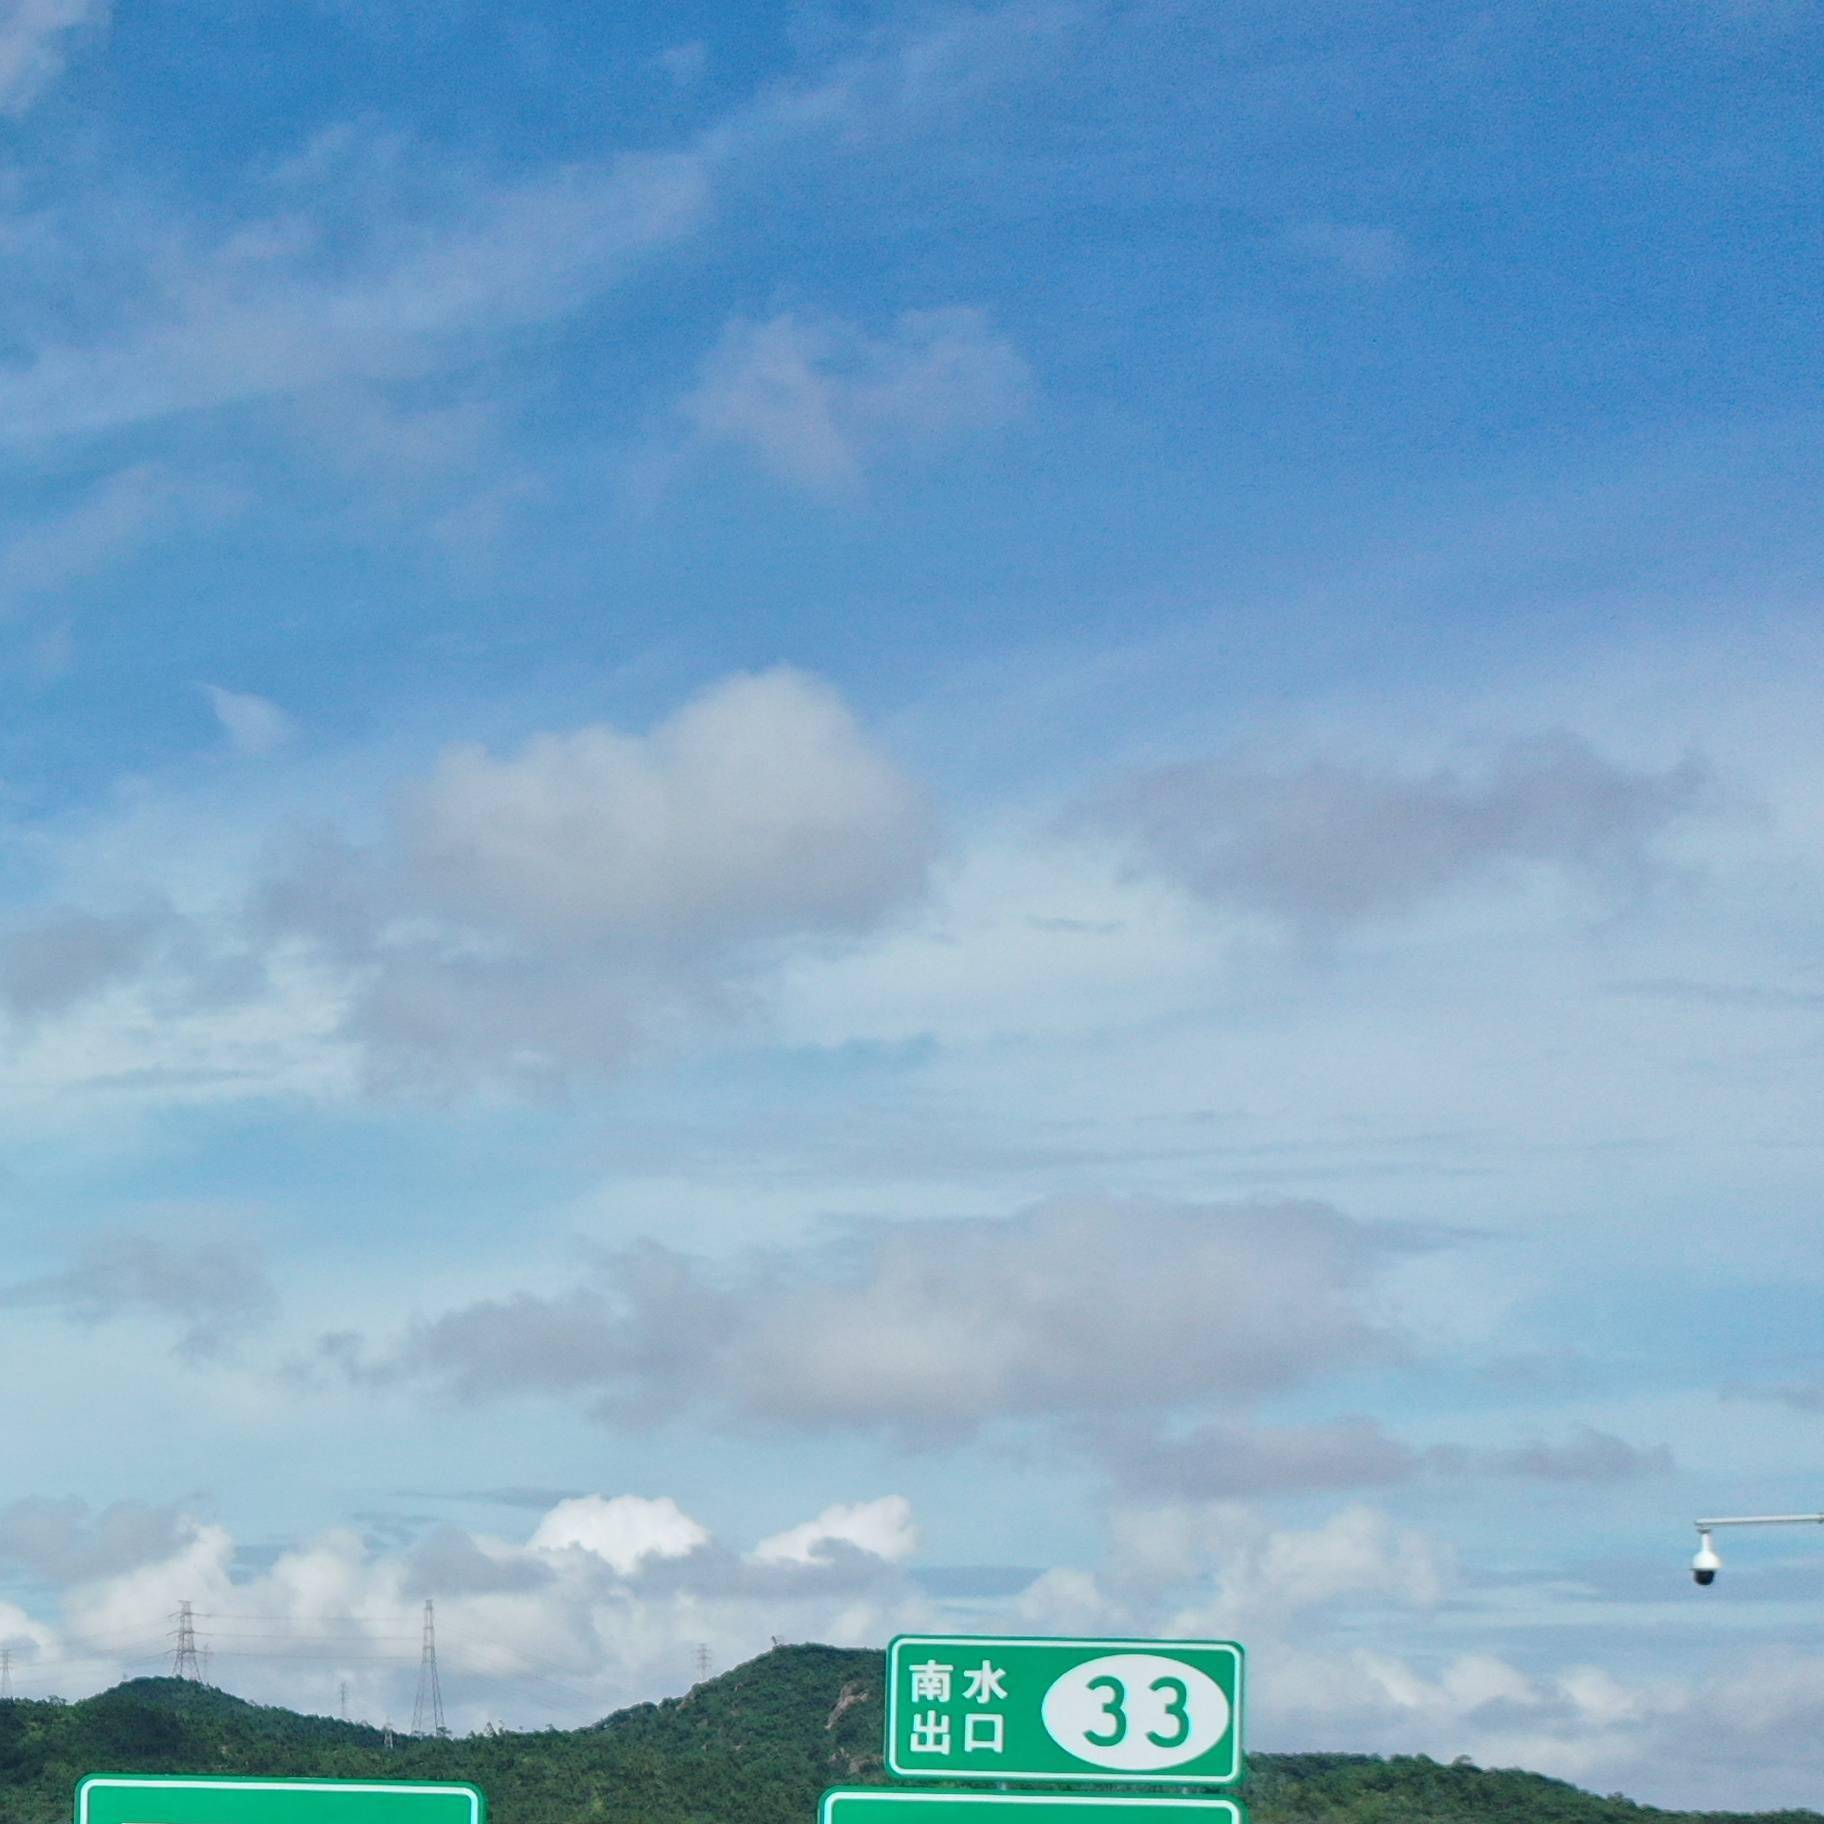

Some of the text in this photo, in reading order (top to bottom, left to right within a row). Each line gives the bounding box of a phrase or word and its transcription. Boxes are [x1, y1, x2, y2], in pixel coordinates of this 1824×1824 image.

[909, 1659, 1008, 1704] 南水
[910, 1710, 1004, 1755] 出口
[1082, 1674, 1192, 1748] 33
